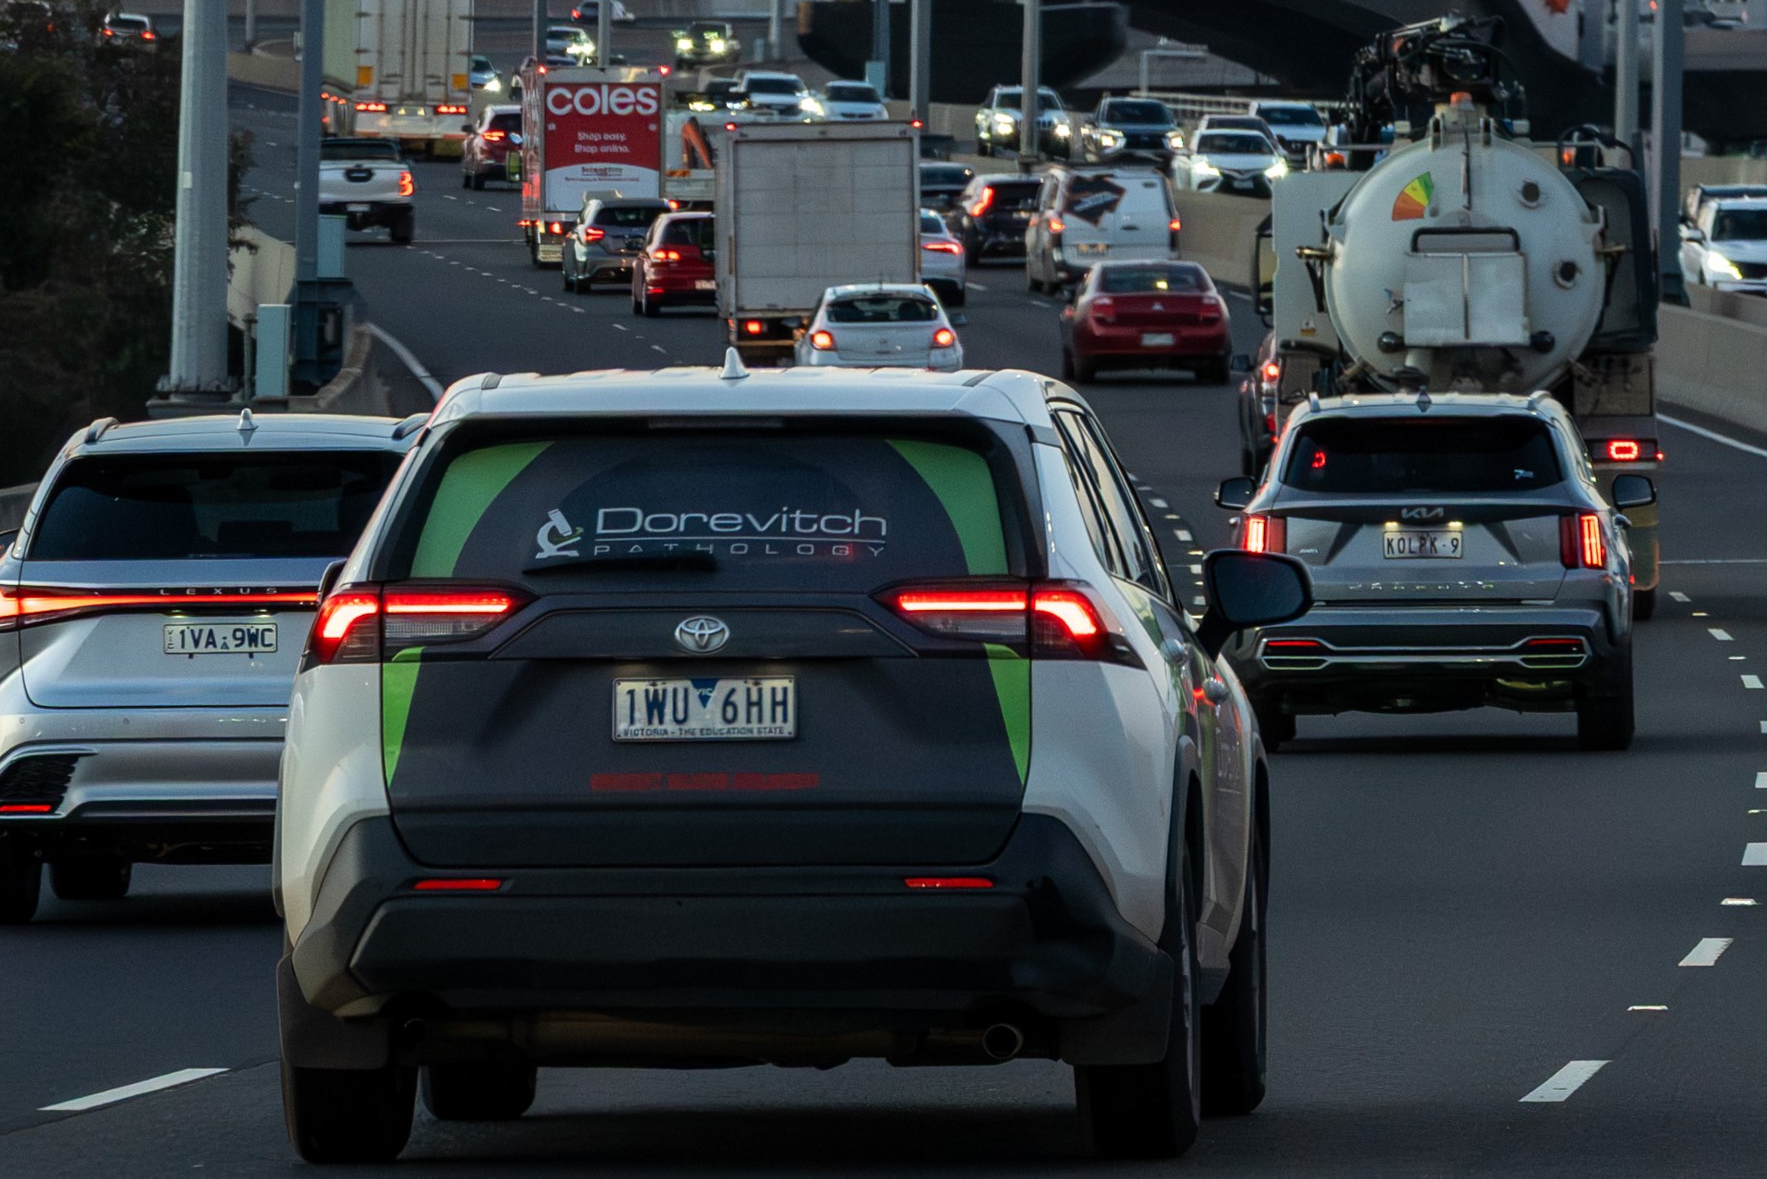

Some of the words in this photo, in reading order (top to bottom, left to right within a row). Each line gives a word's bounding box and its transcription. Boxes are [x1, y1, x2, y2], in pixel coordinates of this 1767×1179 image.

[546, 84, 658, 116] coles
[595, 506, 887, 536] Dorevitch
[593, 543, 885, 558] PATHOLOGY
[160, 587, 277, 595] LEXUS
[626, 686, 689, 726] 1WU
[722, 686, 788, 725] 6HH
[624, 726, 669, 737] VICTORIA
[679, 727, 697, 736] THE
[700, 726, 754, 736] EDUCATION
